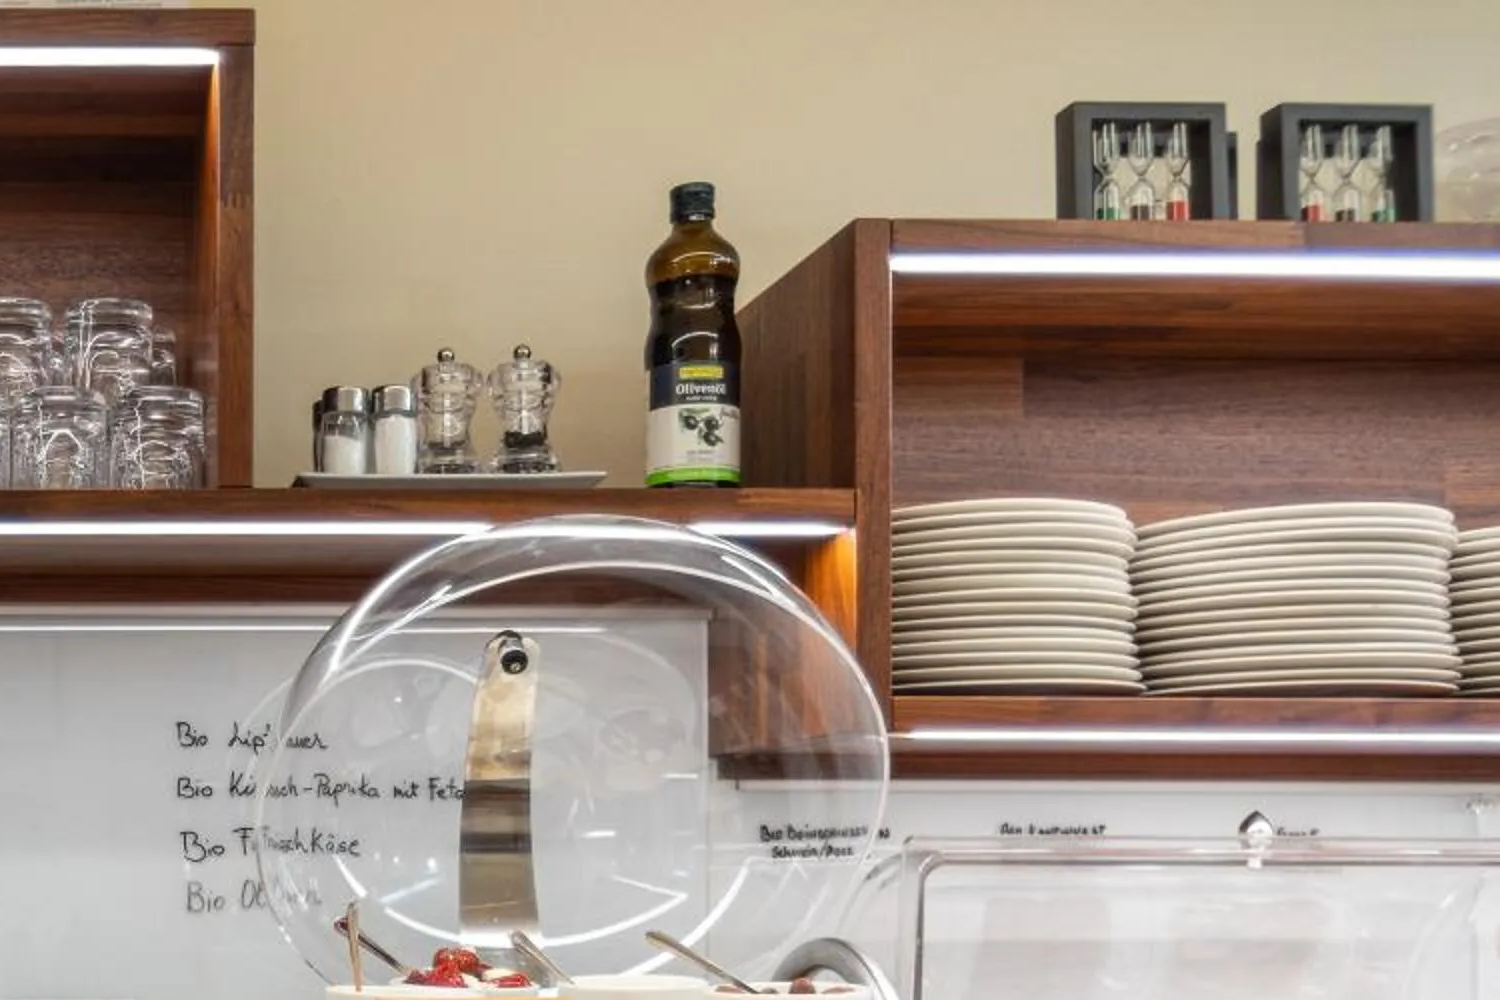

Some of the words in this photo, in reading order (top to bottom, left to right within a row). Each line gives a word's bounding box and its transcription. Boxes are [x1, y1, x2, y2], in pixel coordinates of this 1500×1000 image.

[176, 721, 209, 748] Bio
[177, 776, 214, 799] Bio
[179, 830, 226, 863] Bio
[186, 881, 227, 913] Bio
